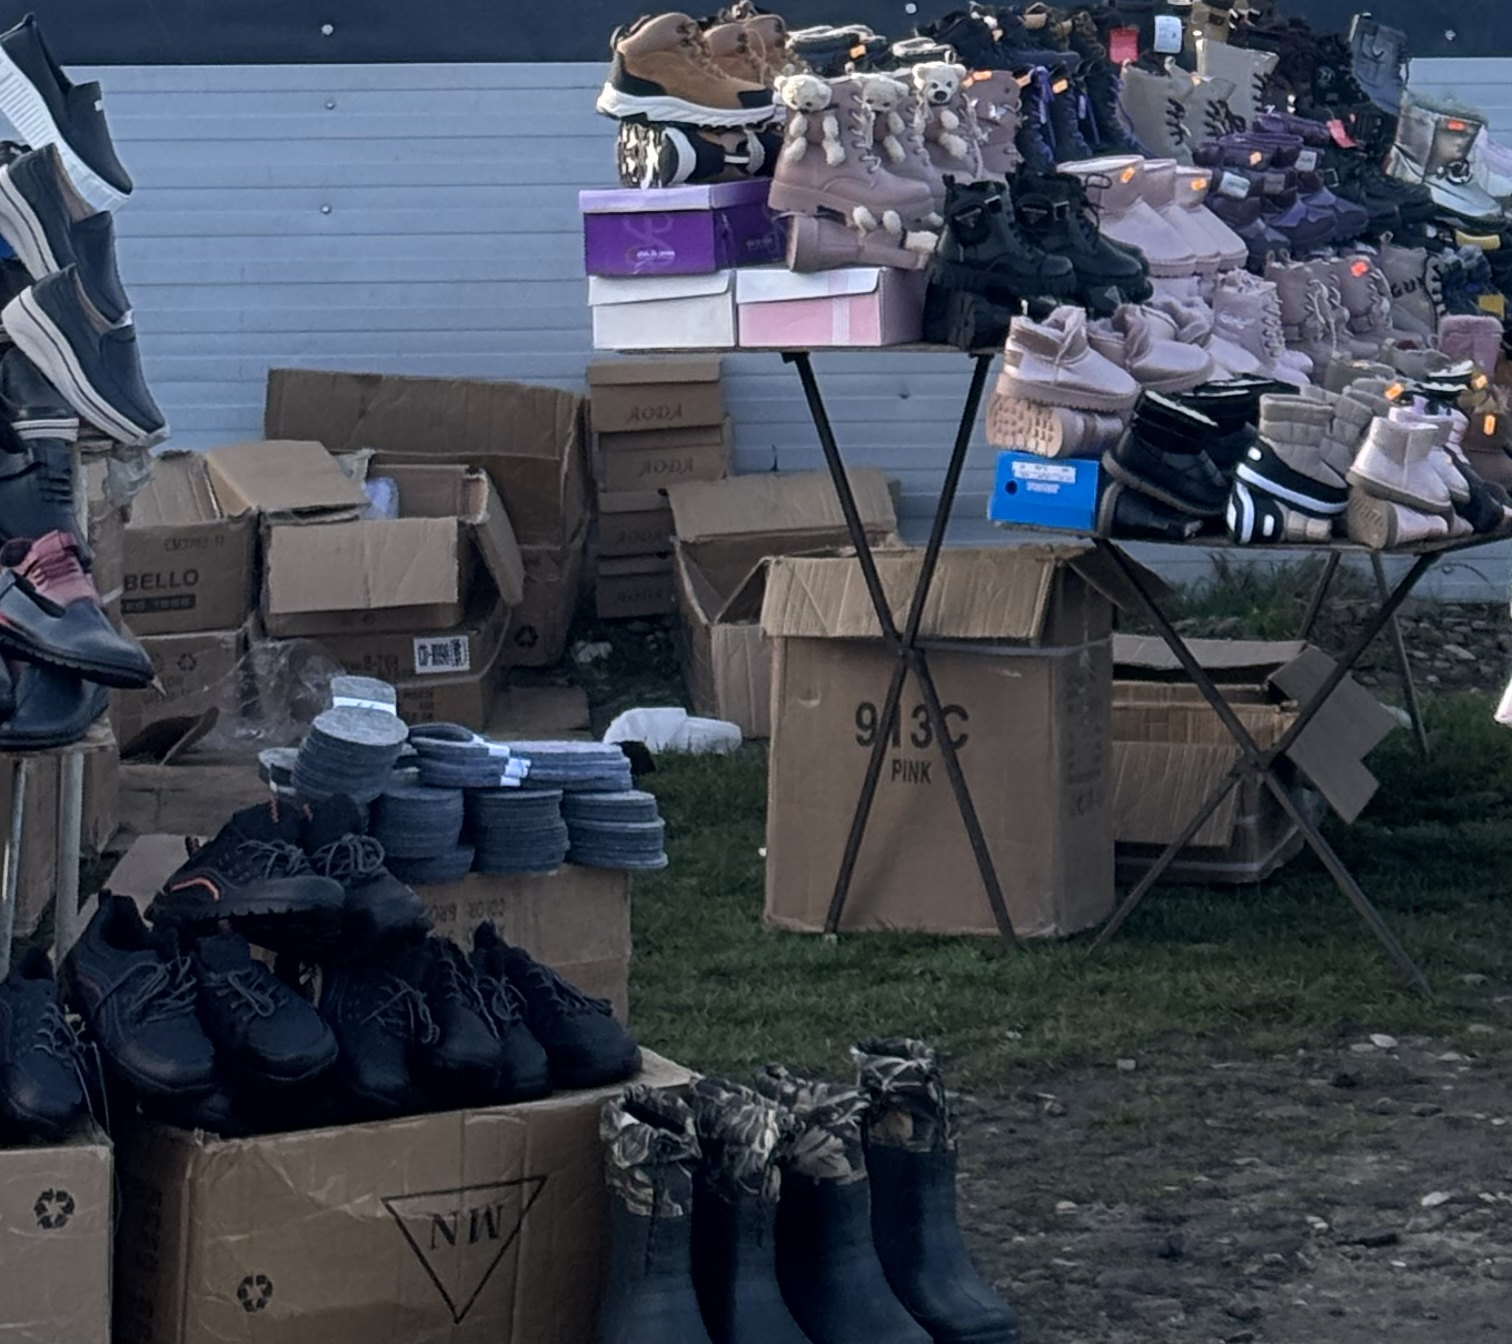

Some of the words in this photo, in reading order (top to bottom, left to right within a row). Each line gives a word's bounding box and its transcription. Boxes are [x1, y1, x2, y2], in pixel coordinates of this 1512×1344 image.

[123, 569, 199, 591] BELLO
[855, 701, 969, 749] 913C
[891, 758, 931, 784] PINK
